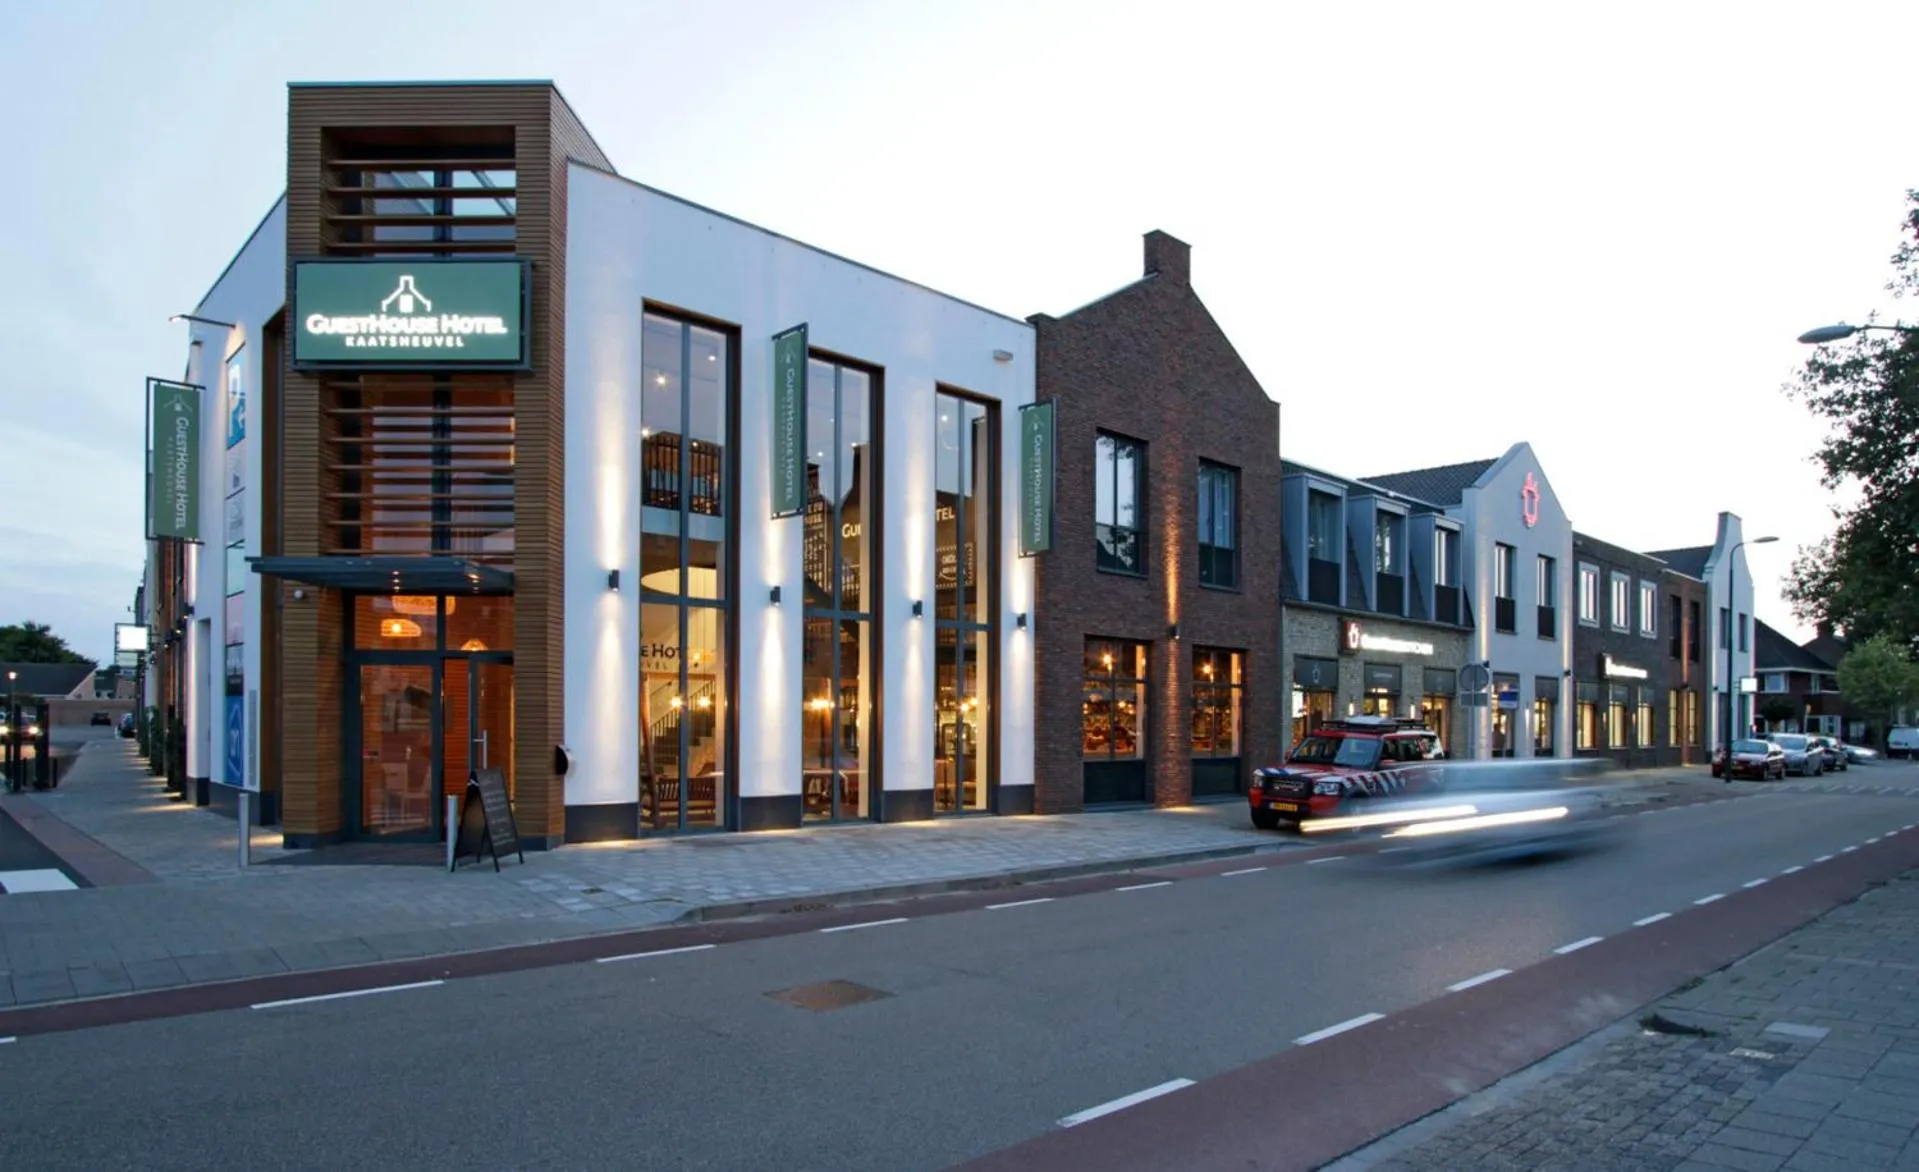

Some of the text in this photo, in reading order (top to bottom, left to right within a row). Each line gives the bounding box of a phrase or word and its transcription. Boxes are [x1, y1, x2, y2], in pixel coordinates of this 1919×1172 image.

[306, 313, 508, 335] GUESTHOUSE HOTEL
[345, 335, 465, 348] KAATSHEUVEL
[174, 416, 190, 530] GUESTHOUSE HOTEL
